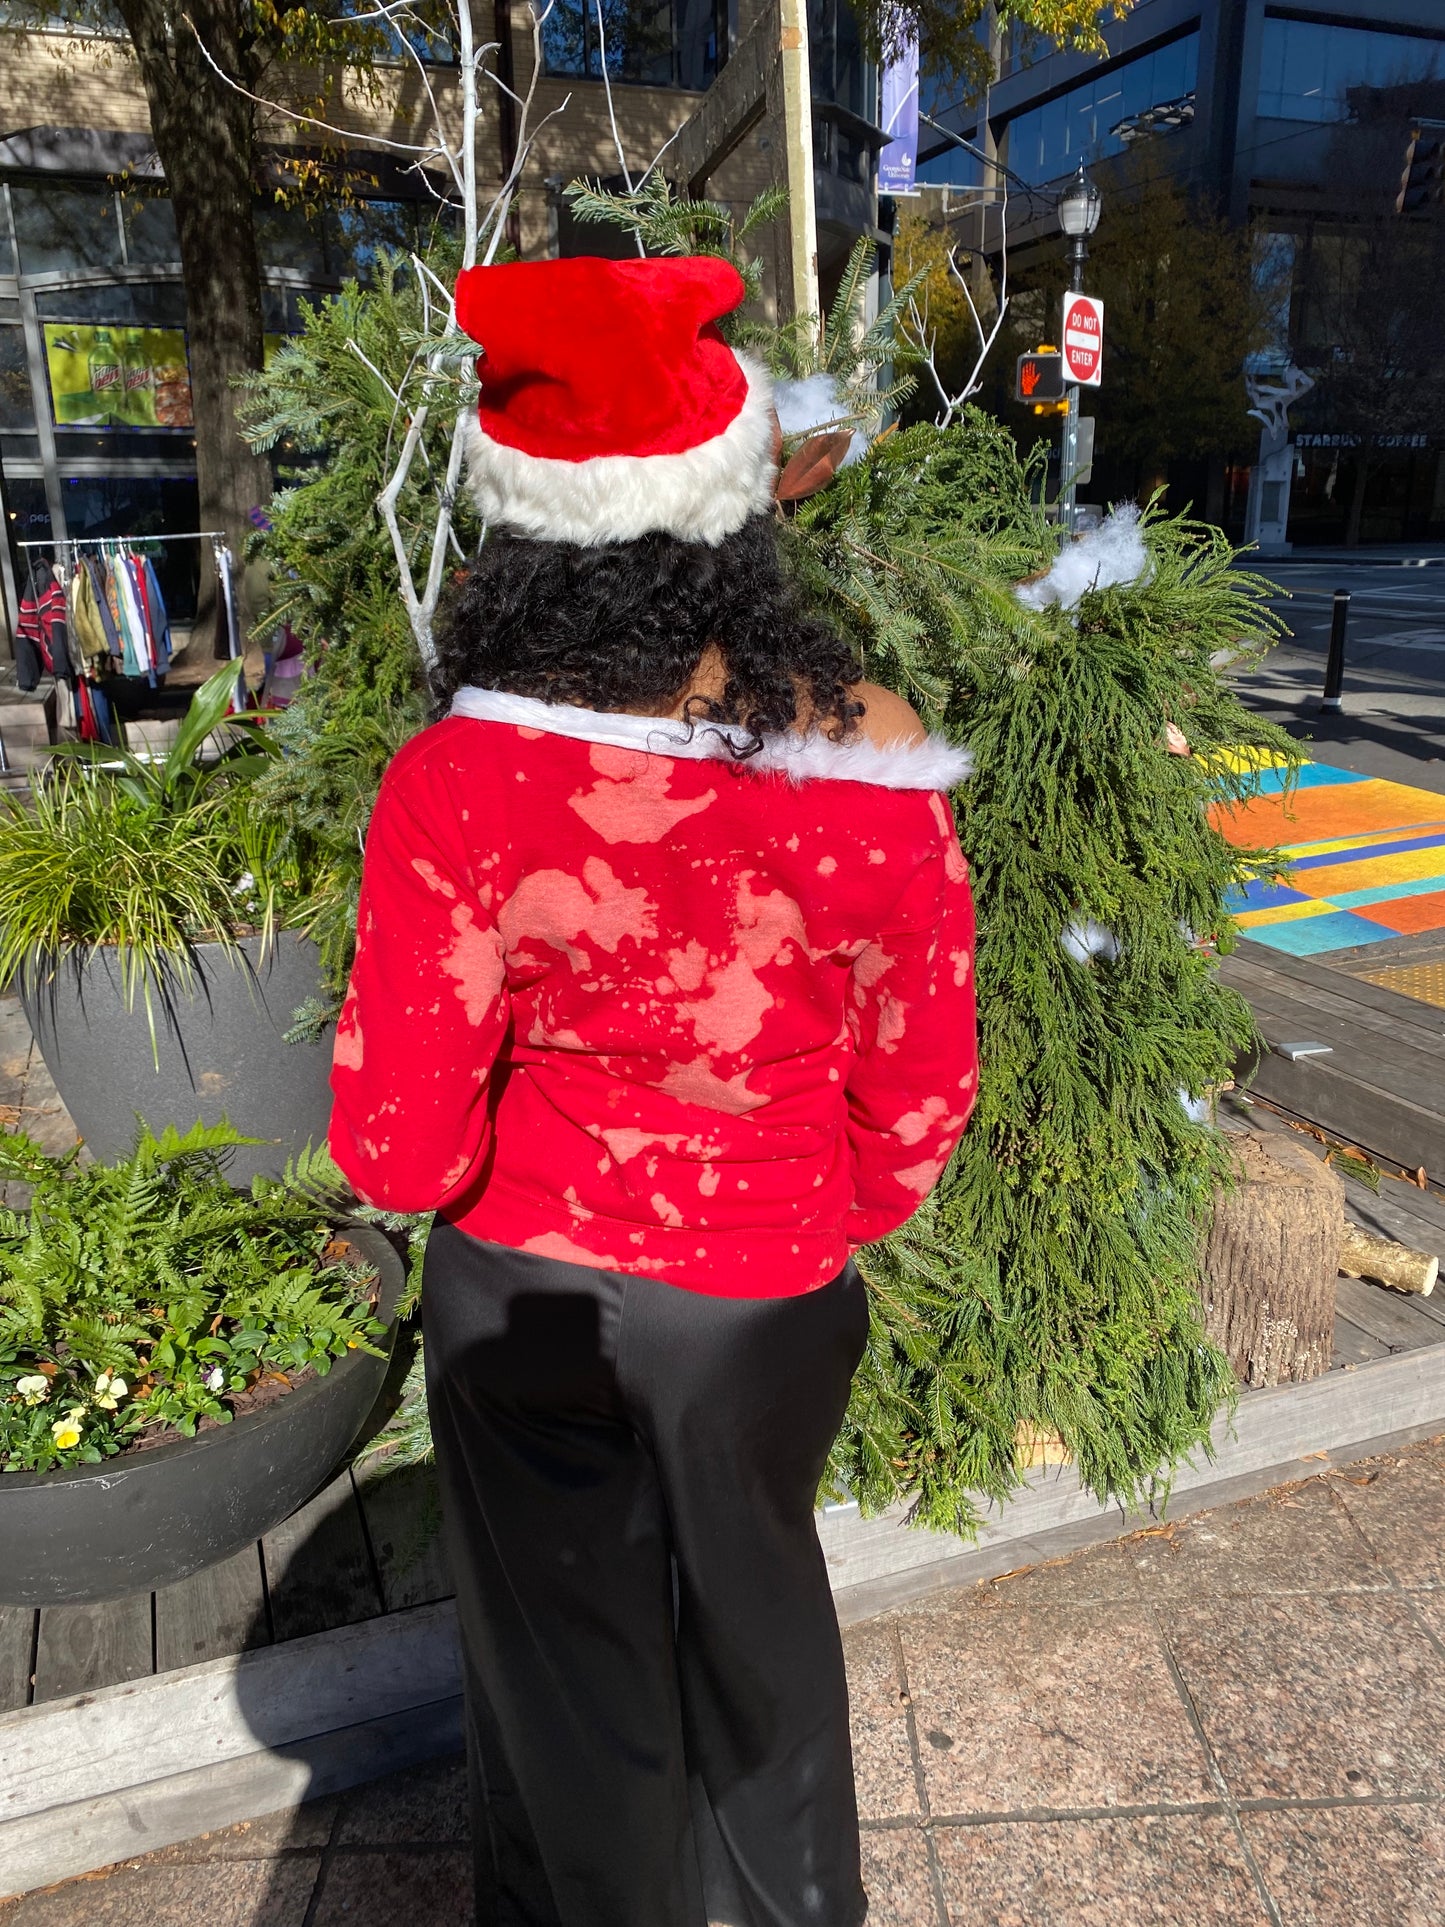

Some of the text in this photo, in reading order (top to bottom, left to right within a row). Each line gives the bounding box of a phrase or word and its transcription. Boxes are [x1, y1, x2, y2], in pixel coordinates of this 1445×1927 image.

[1072, 313, 1097, 331] DO NOT
[1071, 349, 1093, 367] ENTER
[1296, 434, 1375, 447] STARBUC
